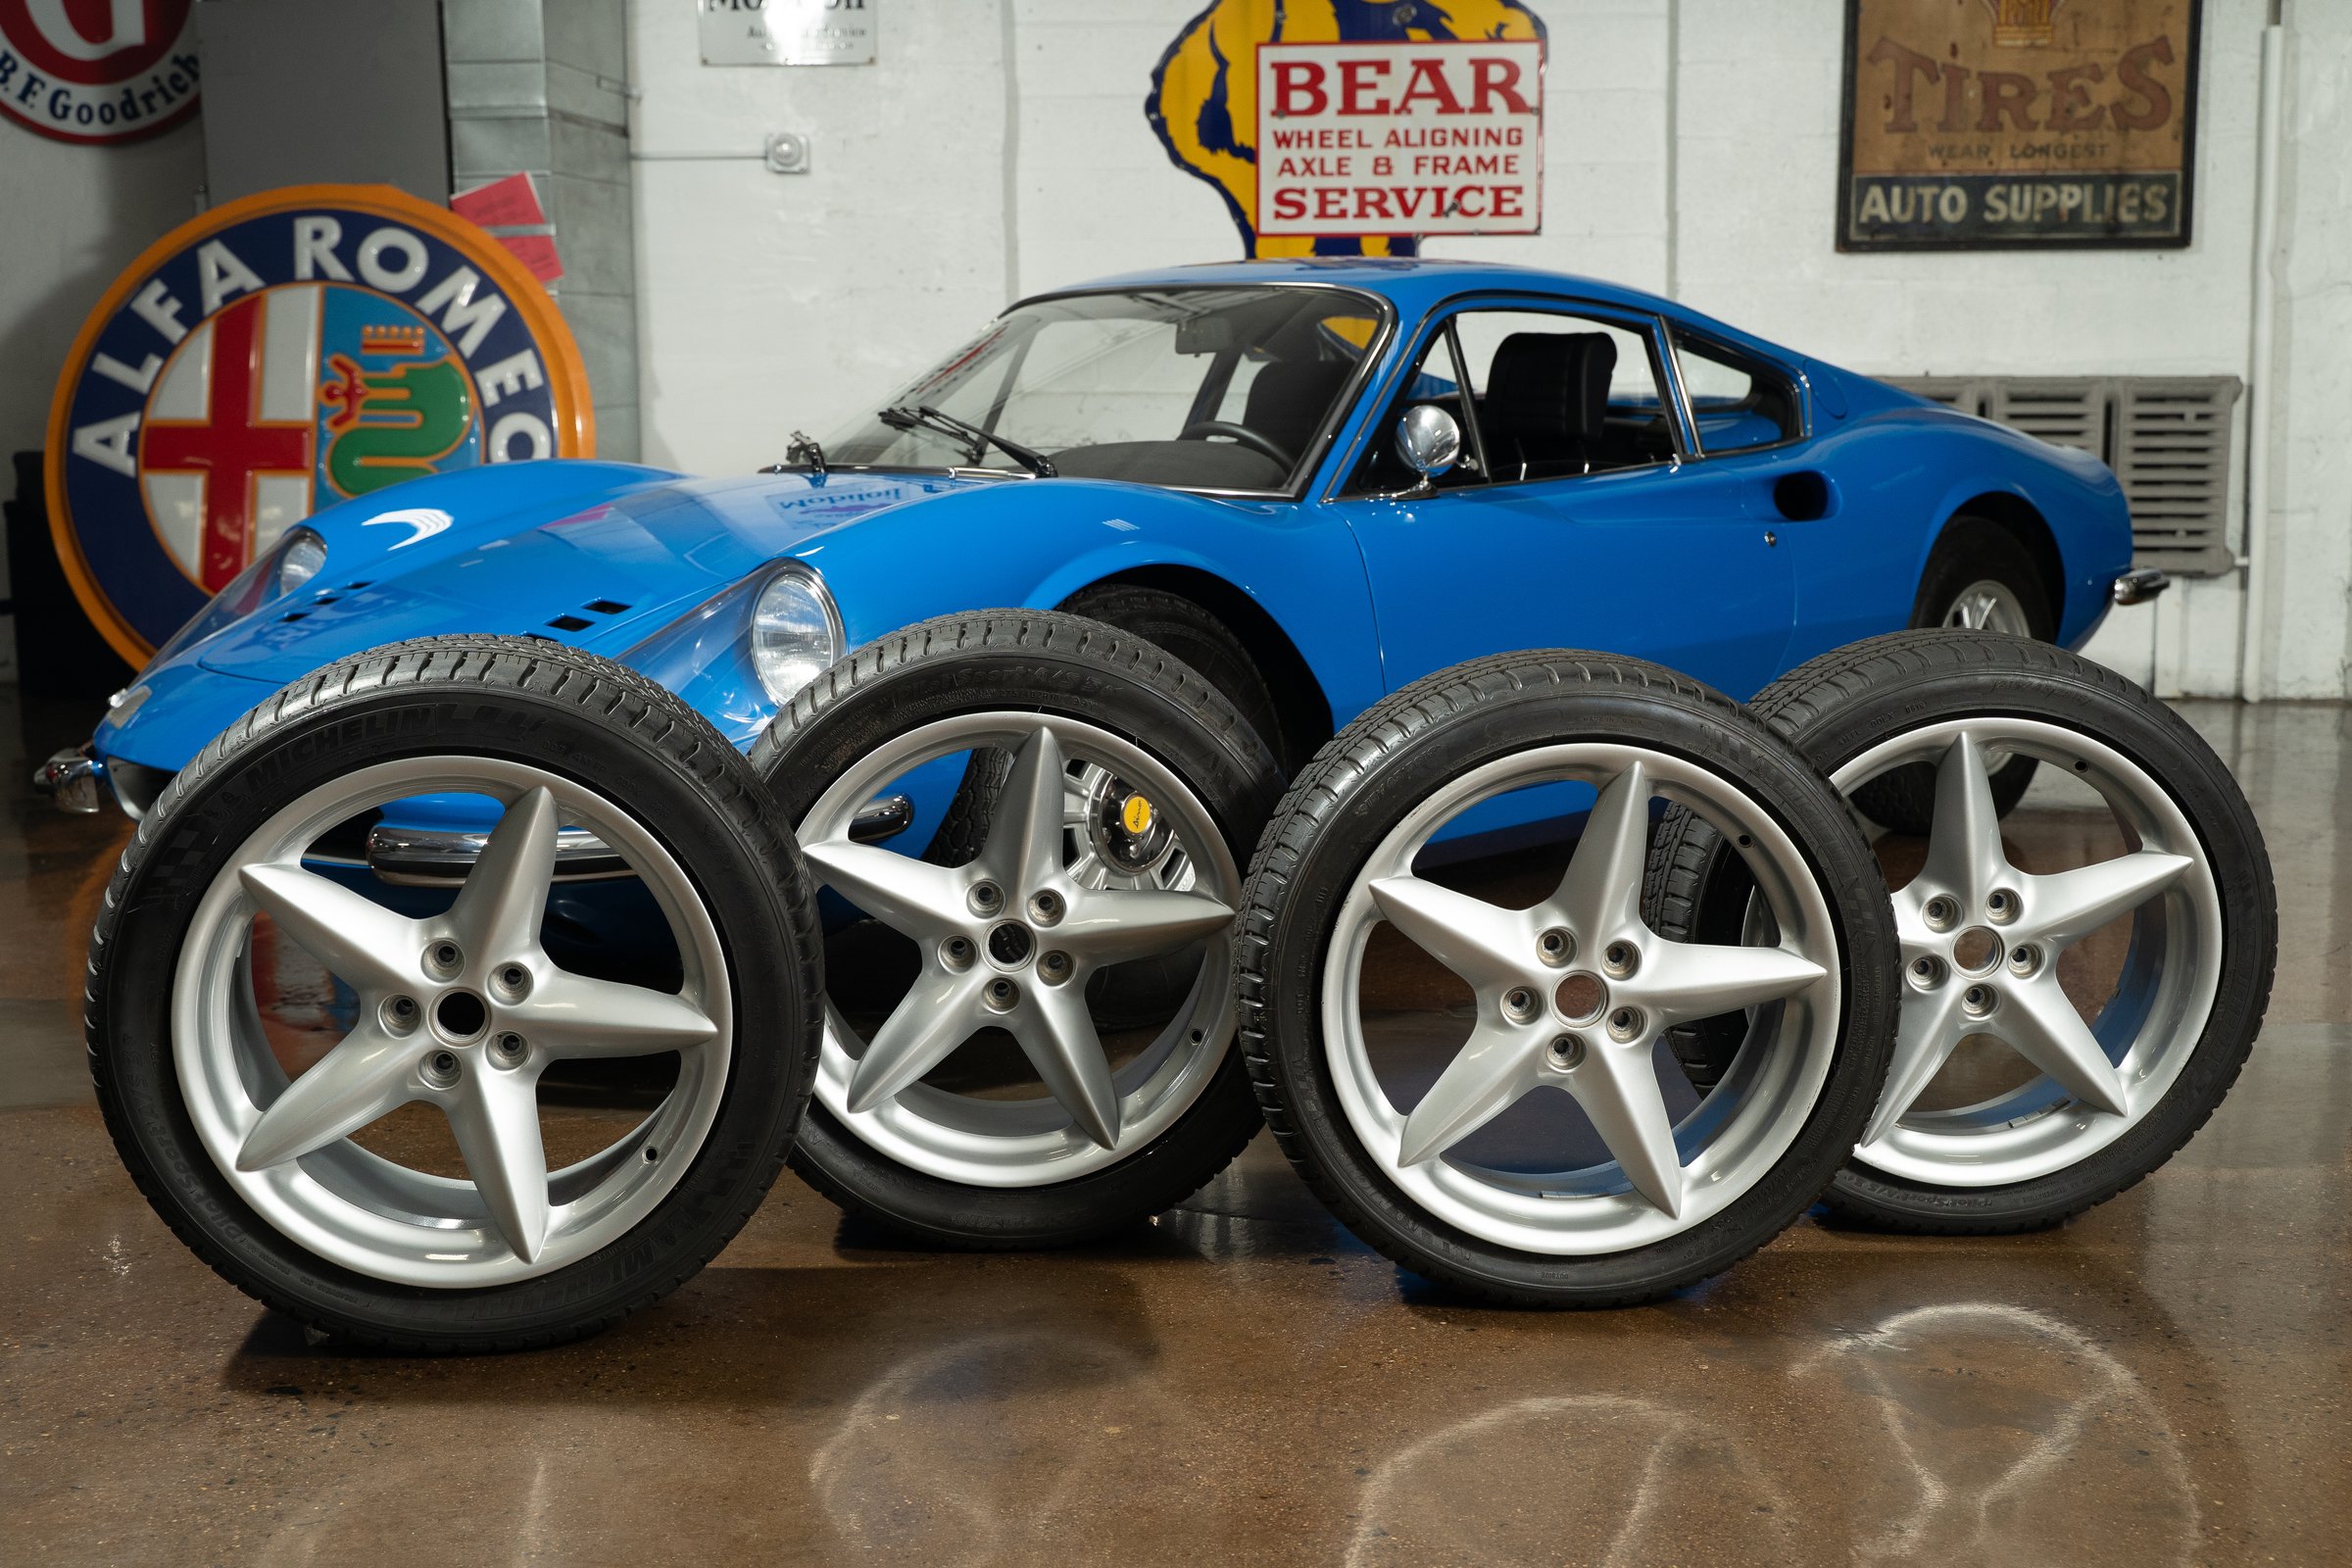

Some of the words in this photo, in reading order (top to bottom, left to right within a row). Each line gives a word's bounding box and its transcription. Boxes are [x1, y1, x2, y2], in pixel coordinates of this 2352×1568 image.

[1270, 58, 1540, 118] BEAR
[1866, 35, 2175, 134] TIRES
[1274, 129, 1372, 149] WHEEL
[1384, 127, 1523, 148] ALIGNING
[1928, 144, 1991, 160] WEAR
[2009, 143, 2110, 160] LONGEST
[1278, 157, 1351, 177] AXLE
[1372, 157, 1394, 176] &
[1414, 154, 1520, 175] FRAME
[1274, 185, 1523, 220] SERVICE
[1859, 184, 1968, 224] AUTO
[1984, 183, 2168, 224] SUPPLIES
[73, 240, 266, 478] ALFA
[295, 216, 551, 463] ROMEO
[244, 704, 433, 789] MICHELIN
